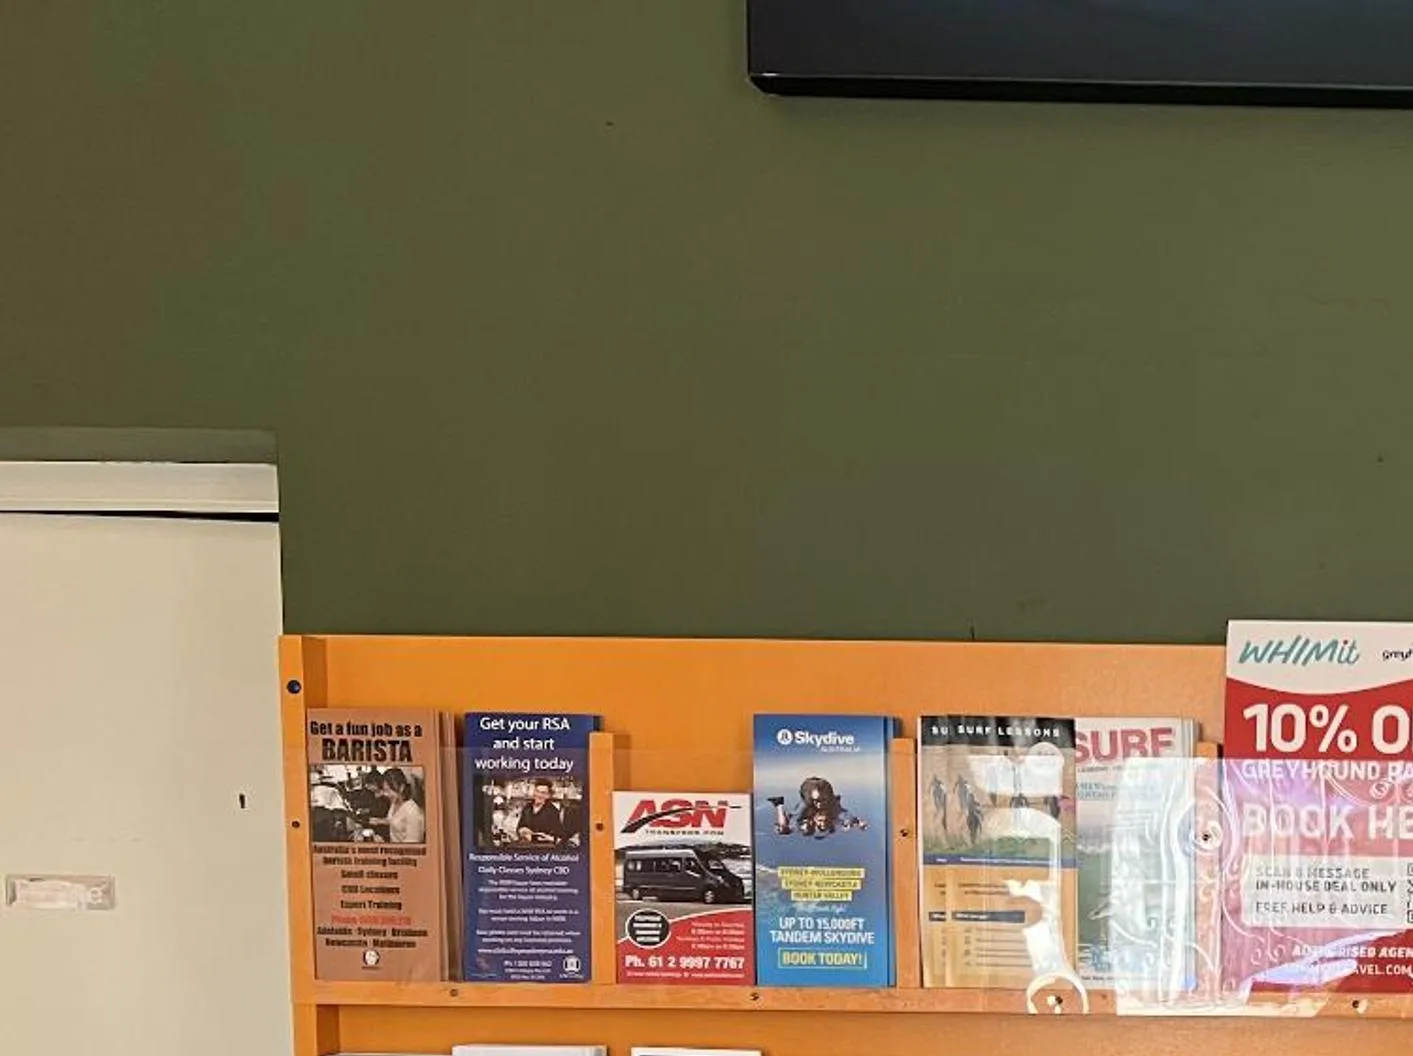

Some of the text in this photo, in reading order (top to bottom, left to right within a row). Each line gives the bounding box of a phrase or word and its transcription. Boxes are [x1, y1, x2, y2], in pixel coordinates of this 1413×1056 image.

[310, 721, 392, 737] Get fun job
[480, 717, 571, 732] Get your RSA
[1243, 703, 1357, 752] 10%
[493, 738, 554, 749] and start
[795, 730, 854, 747] Skydive
[1075, 727, 1173, 764] SURF
[322, 739, 412, 762] BARISTA
[475, 757, 573, 771] working today
[1361, 881, 1397, 893] ONLY
[1341, 903, 1388, 915] ADVICE
[779, 917, 814, 930] UP TO
[770, 930, 875, 945] TANDEM SKYDIVE
[649, 956, 663, 968] 61
[668, 956, 675, 968] 2
[782, 951, 862, 966] BOOK TODAY!
